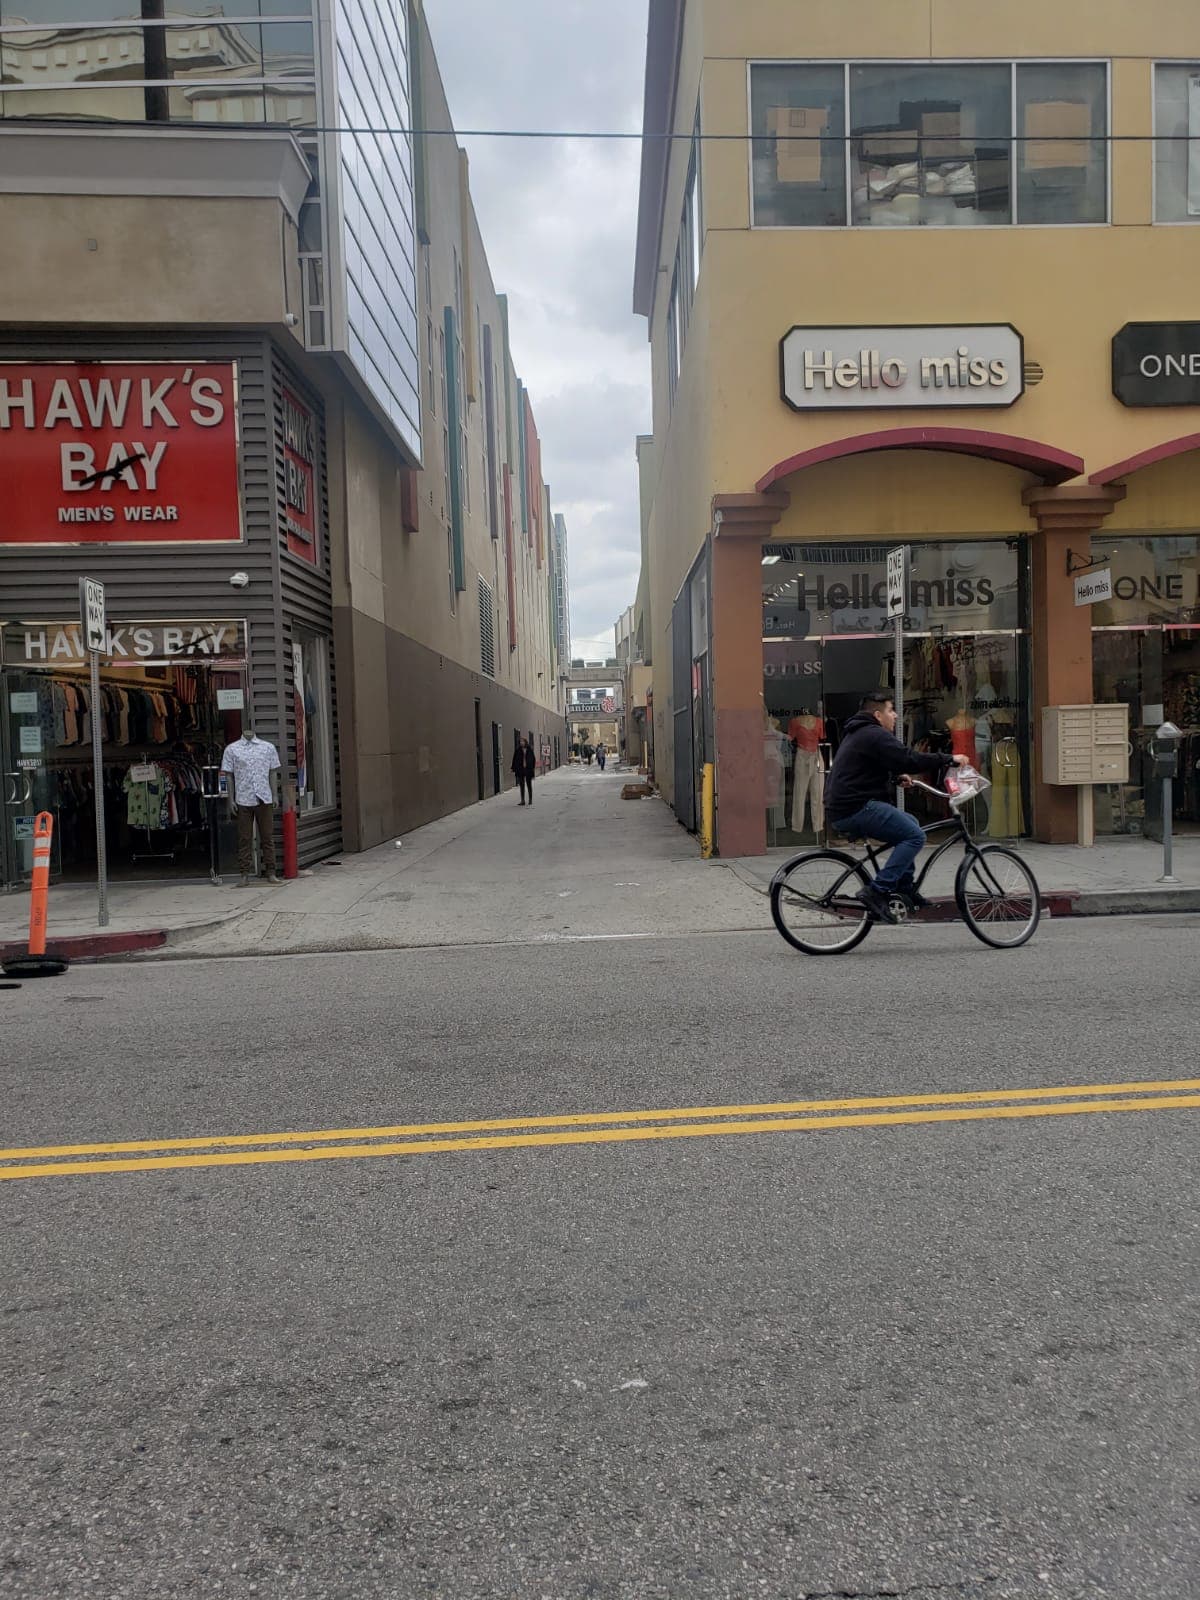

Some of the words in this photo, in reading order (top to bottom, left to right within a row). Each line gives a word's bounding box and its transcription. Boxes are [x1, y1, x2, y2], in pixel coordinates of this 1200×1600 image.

[803, 349, 908, 390] Hello
[920, 346, 1009, 388] miss
[1140, 353, 1200, 378] ONE
[0, 367, 225, 429] HAWK'S
[60, 441, 168, 492] BAY
[57, 505, 115, 523] MEN'S
[124, 505, 179, 522] WEAR
[889, 552, 902, 573] ONE
[888, 572, 902, 592] WAY
[911, 568, 995, 608] miss
[1077, 583, 1094, 599] Hello
[1094, 580, 1109, 596] miss
[1113, 574, 1183, 601] ONE
[87, 584, 103, 606] ONE
[88, 605, 104, 625] WAY
[162, 626, 226, 655] BAY
